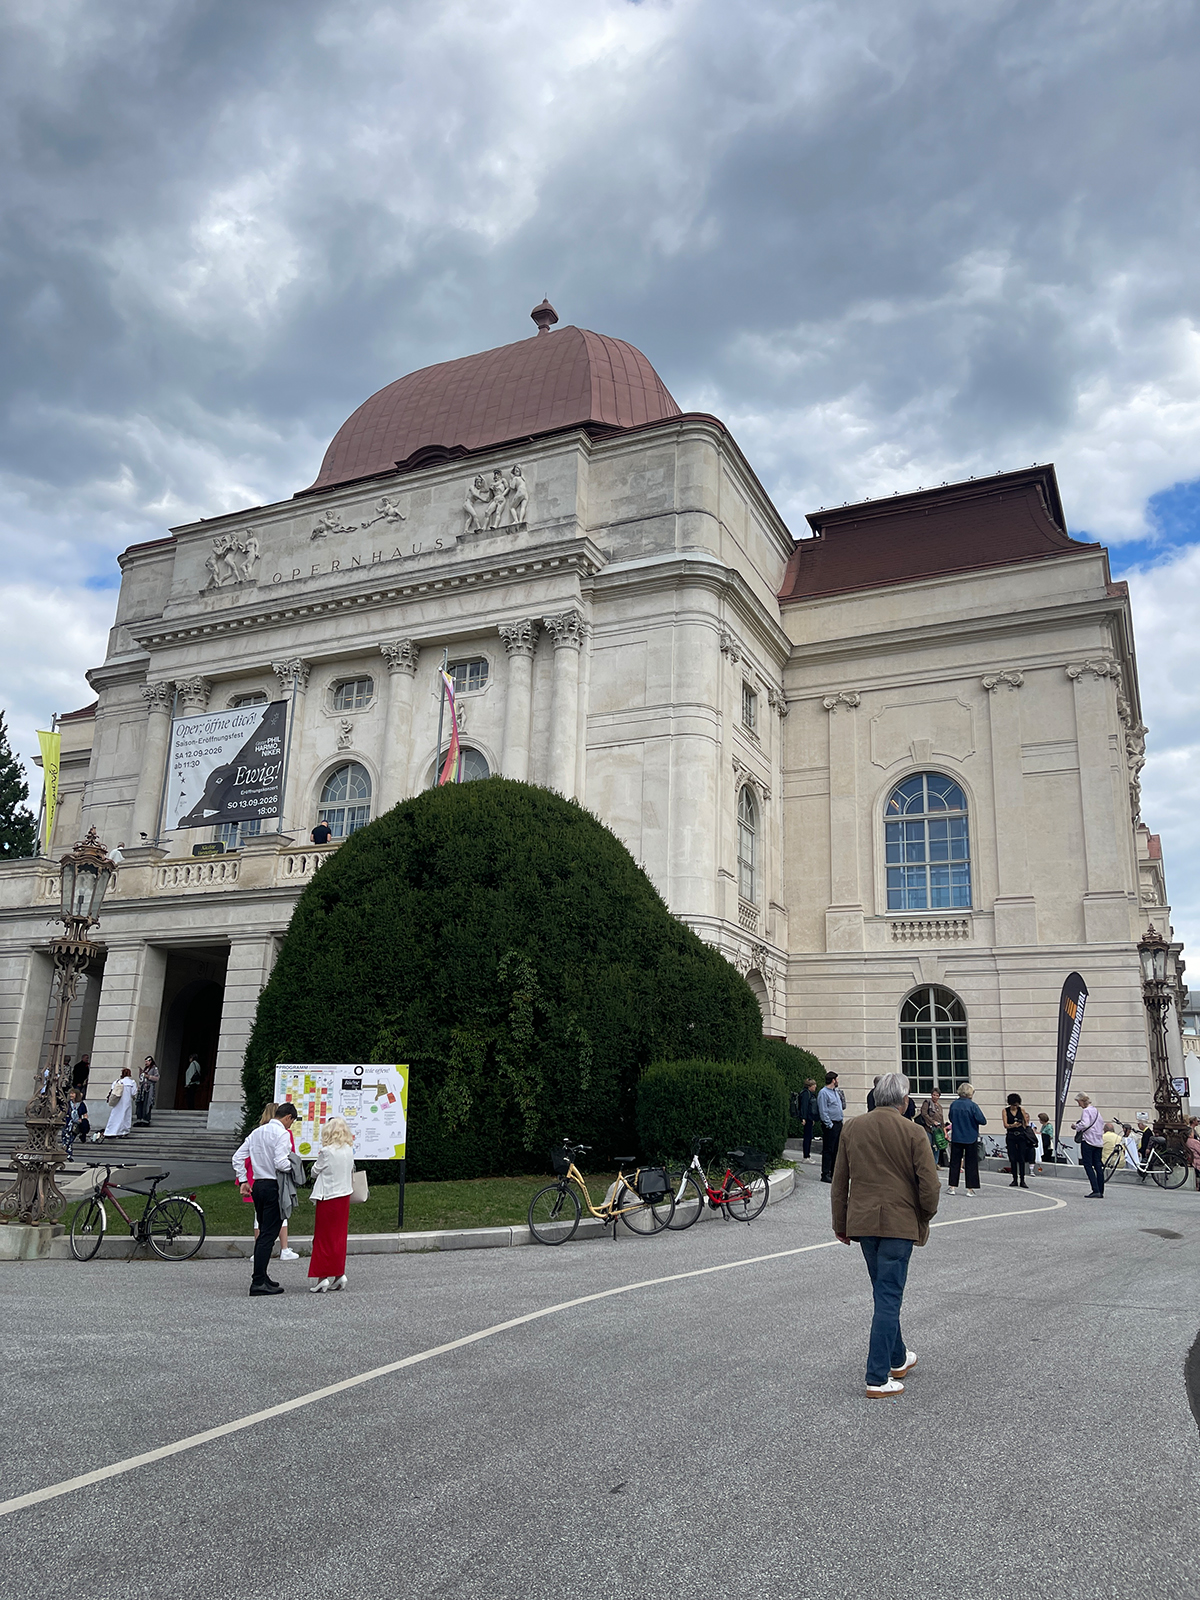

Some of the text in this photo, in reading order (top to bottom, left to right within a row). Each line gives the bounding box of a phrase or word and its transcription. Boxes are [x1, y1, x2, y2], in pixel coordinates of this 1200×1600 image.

[272, 537, 445, 584] OPERNHAUS
[204, 717, 231, 735] öffne
[231, 711, 258, 727] dich!
[175, 731, 244, 748] Saison-Eröffnungsfest
[267, 735, 282, 744] PHIL
[174, 746, 223, 760] SA 12.09.2026
[254, 742, 278, 753] HARMO
[173, 759, 201, 770] ab 11:30
[233, 760, 282, 786] Ewig!
[227, 795, 278, 809] SO 13.09.2026
[257, 806, 278, 815] 18:00
[1066, 991, 1086, 1060] SOUNDPORTAL
[353, 1065, 364, 1076] O
